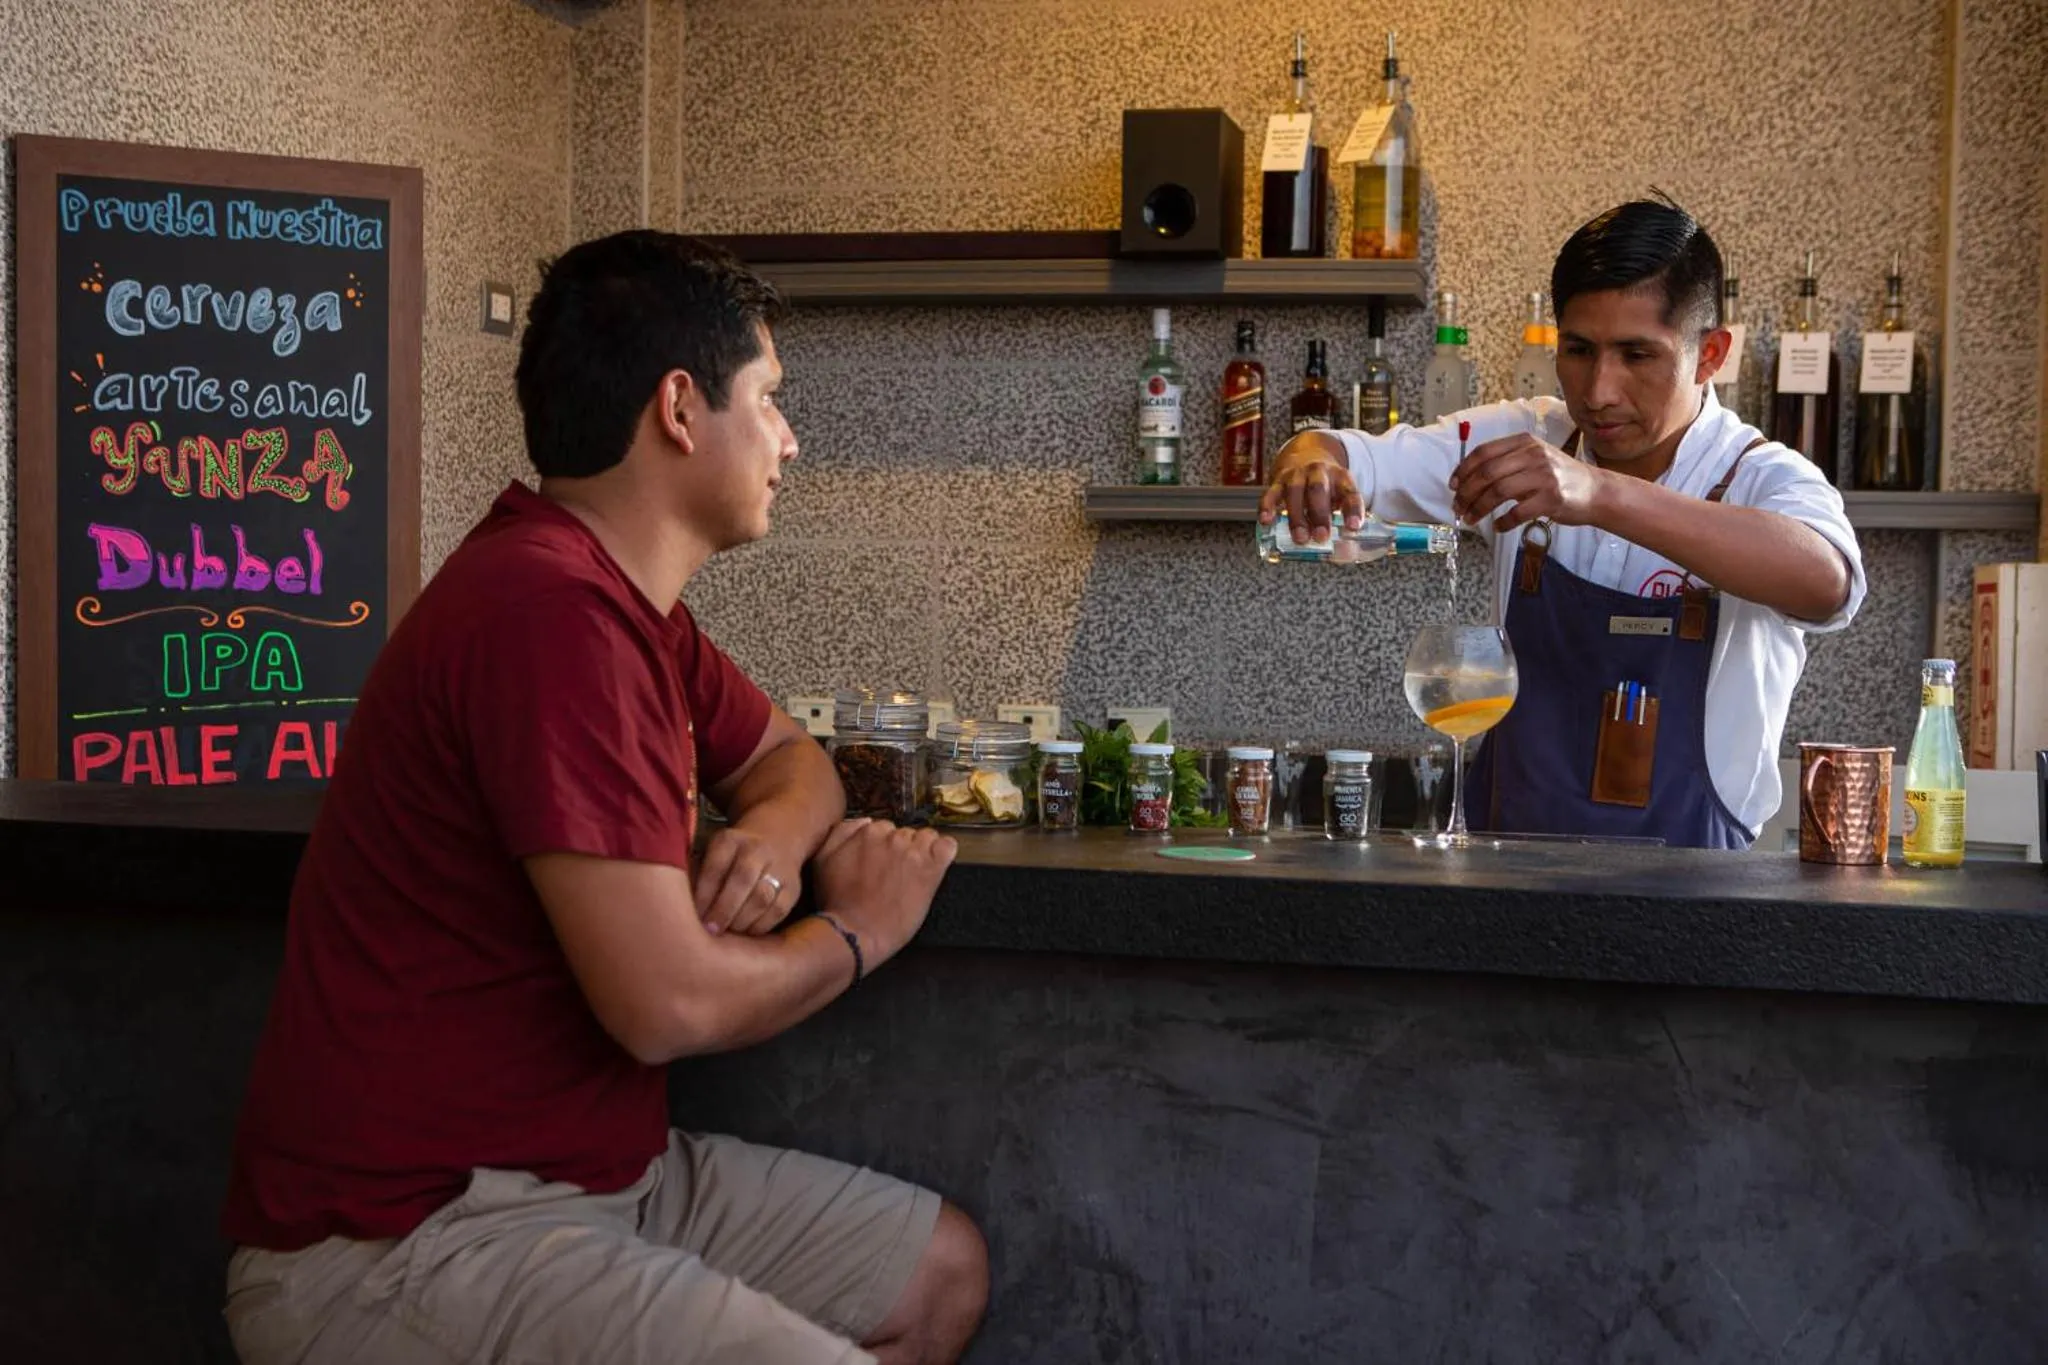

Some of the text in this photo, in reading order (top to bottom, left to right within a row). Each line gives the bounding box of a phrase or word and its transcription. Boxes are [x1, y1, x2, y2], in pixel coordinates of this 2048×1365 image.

[227, 194, 383, 250] Nuestra
[105, 279, 343, 357] Cerveza
[88, 523, 324, 595] Dubbel
[163, 632, 303, 698] IPA
[73, 725, 239, 785] PALE
[1340, 813, 1357, 823] GO
